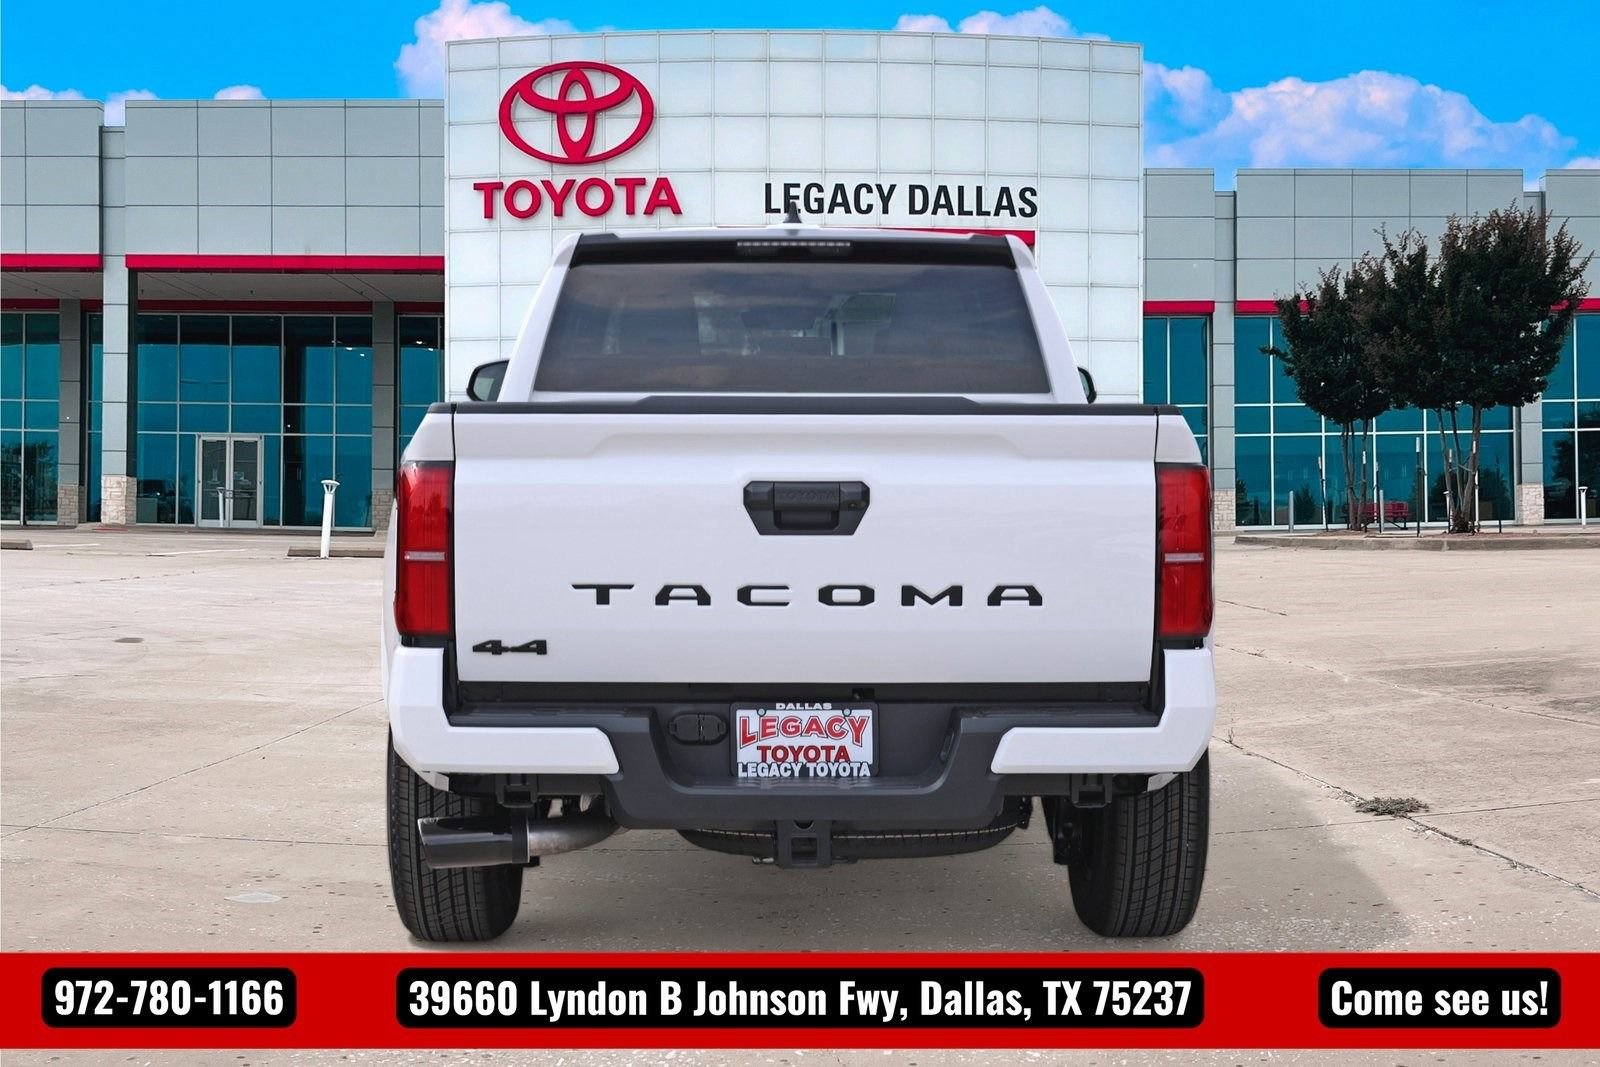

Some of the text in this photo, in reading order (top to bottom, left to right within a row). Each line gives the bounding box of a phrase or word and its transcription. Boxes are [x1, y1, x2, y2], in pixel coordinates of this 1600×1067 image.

[473, 176, 682, 219] TOYOTA
[764, 182, 1039, 218] LEGACY DALLAS
[780, 487, 837, 503] OYOTA
[571, 584, 1043, 606] TACOMA
[776, 702, 833, 711] DALLAS
[739, 714, 870, 748] LEGACY
[757, 745, 851, 763] TOYOTA
[738, 763, 871, 777] LEGACY TOYOTA
